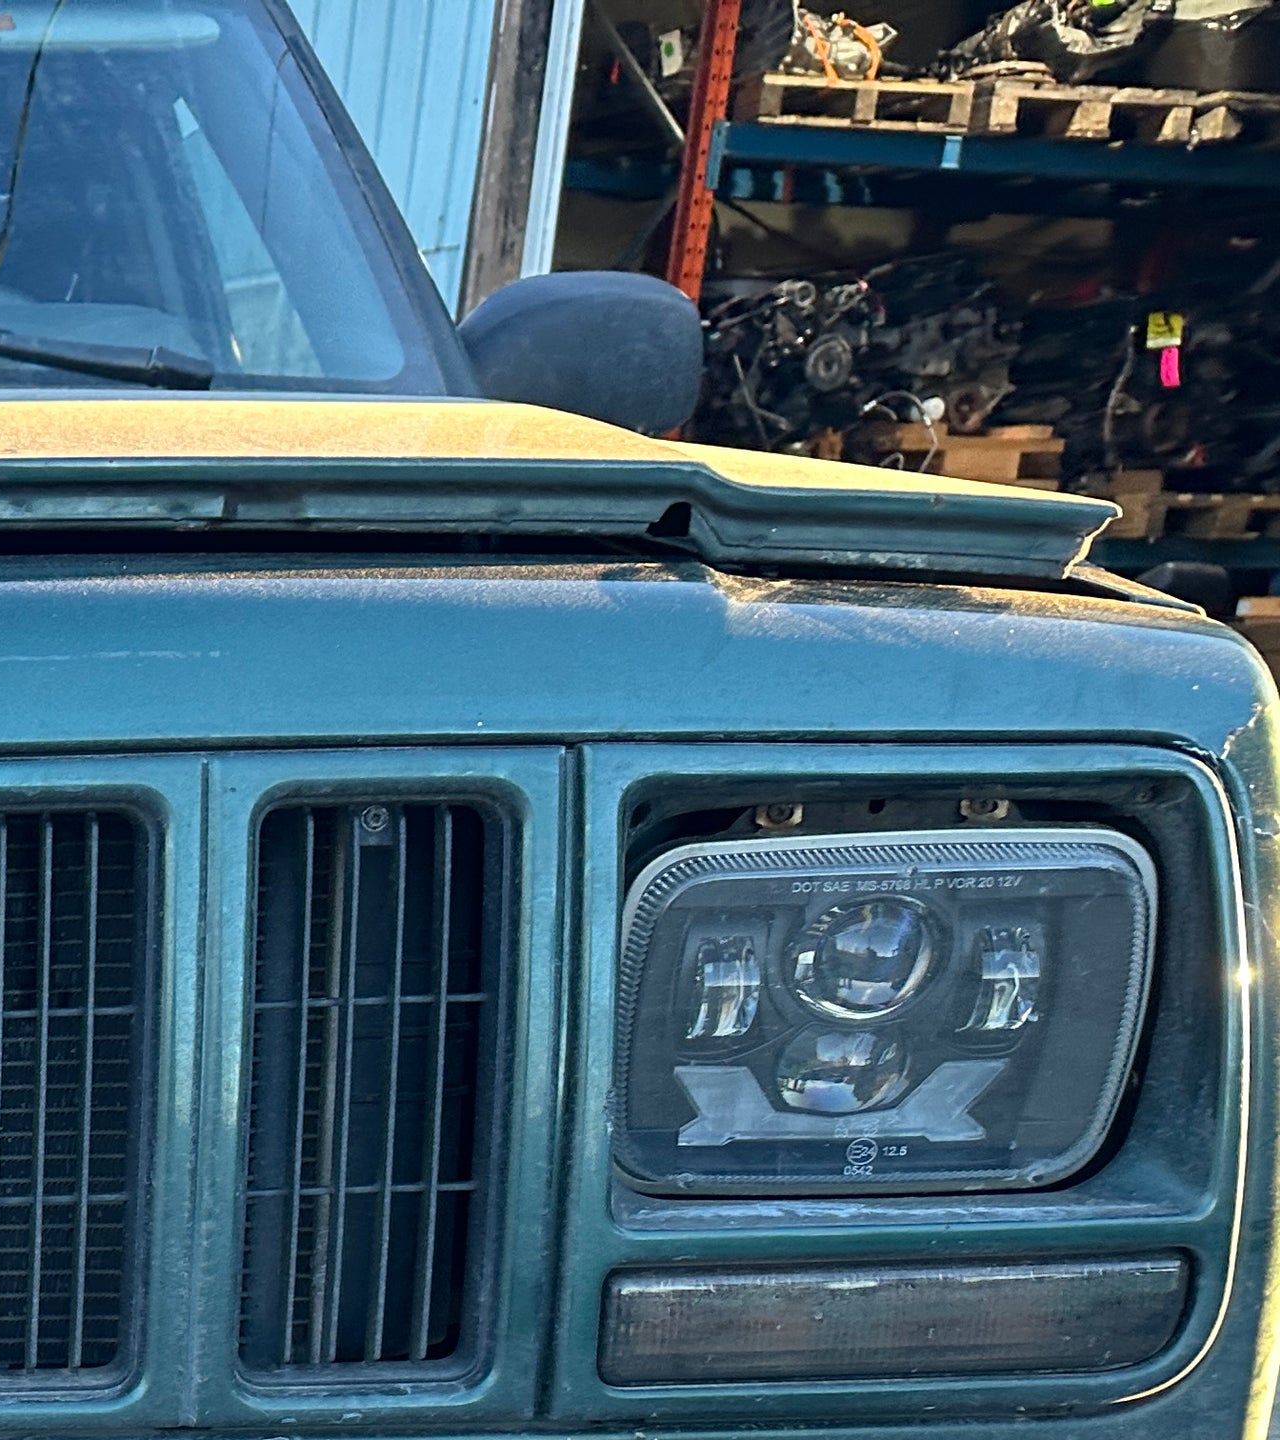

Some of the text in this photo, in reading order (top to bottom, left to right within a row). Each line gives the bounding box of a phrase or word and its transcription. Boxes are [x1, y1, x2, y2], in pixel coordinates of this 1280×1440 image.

[791, 881, 822, 893] DOT
[822, 880, 850, 893] SAE
[934, 877, 945, 889] P
[946, 877, 977, 889] VOR
[977, 876, 994, 889] 20
[997, 875, 1023, 888] 12V
[843, 1165, 874, 1176] 0542
